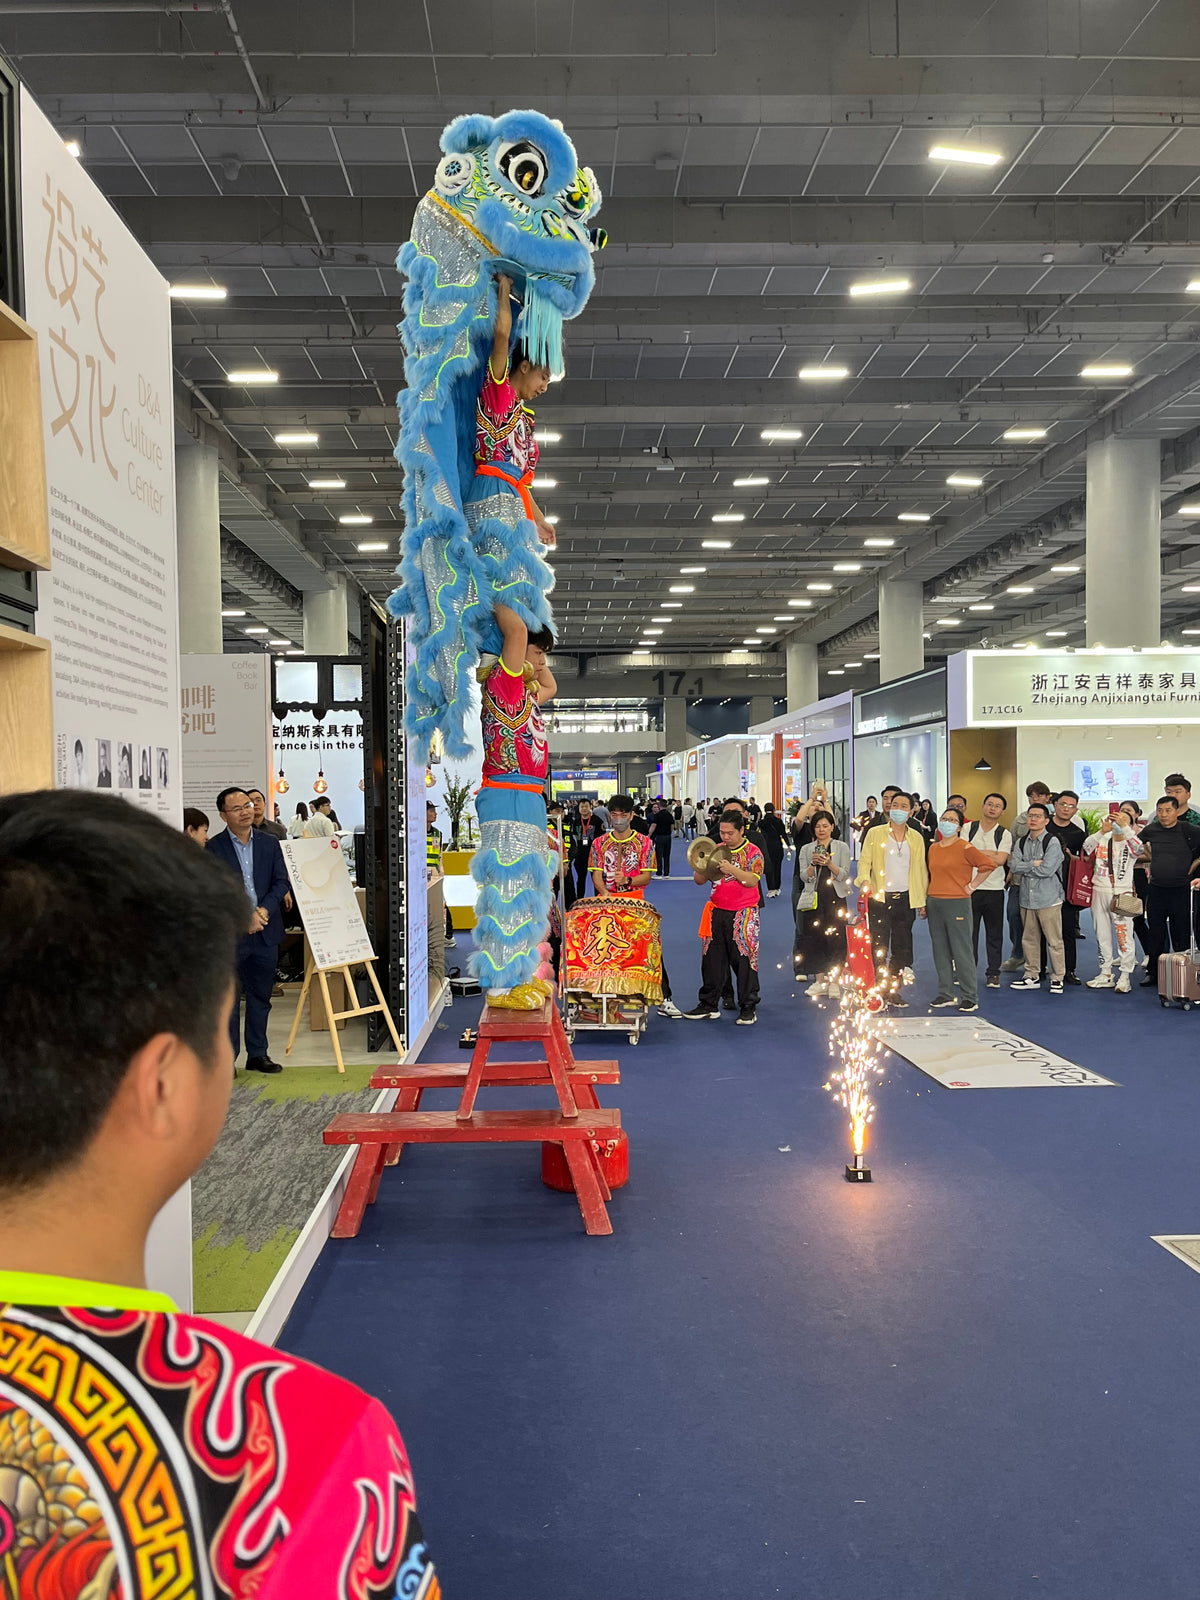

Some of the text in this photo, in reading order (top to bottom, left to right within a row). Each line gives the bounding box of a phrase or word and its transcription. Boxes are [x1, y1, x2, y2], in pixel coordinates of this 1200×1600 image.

[48, 325, 118, 482] 文化
[138, 373, 162, 425] D&A
[121, 407, 163, 471] Culture
[127, 461, 164, 515] Center
[231, 660, 258, 670] Coffee
[236, 671, 258, 680] Book
[652, 670, 704, 696] 17.1
[1032, 672, 1197, 690] 浙江安吉祥泰家具
[244, 681, 257, 690] Bar
[1032, 693, 1087, 706] Zhejiang
[1091, 692, 1167, 706] Anjixiangtai
[981, 705, 1023, 714] 17.1C16
[309, 740, 320, 750] is
[322, 740, 334, 750] in
[336, 740, 355, 750] the
